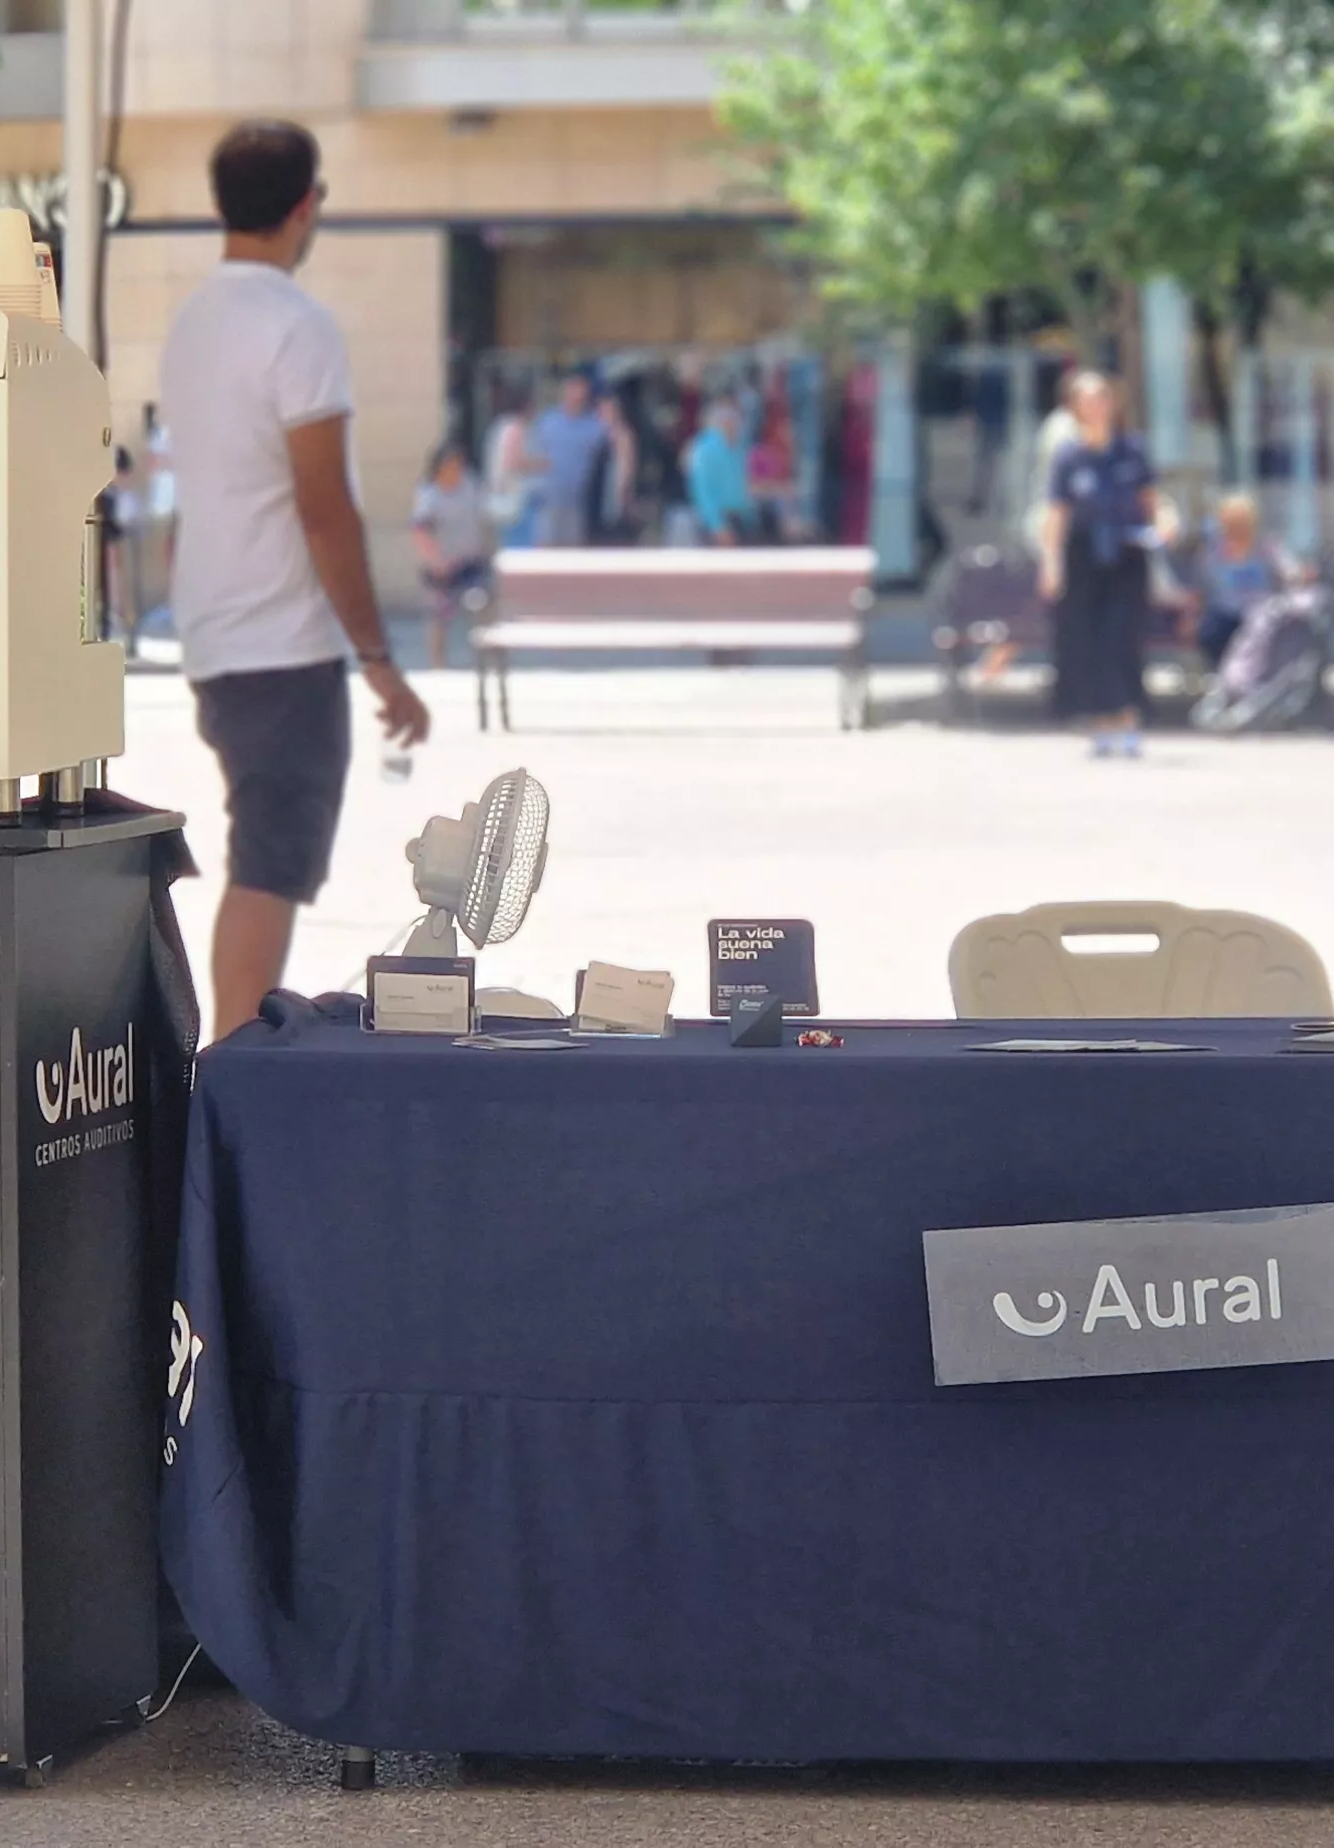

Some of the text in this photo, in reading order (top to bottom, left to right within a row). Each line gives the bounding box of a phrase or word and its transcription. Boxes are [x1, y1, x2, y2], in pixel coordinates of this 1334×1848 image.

[718, 927, 786, 939] La vida
[66, 1021, 134, 1121] Aural
[35, 1119, 135, 1167] CENTROS AUDITIVOS
[1082, 1257, 1282, 1334] Aural
